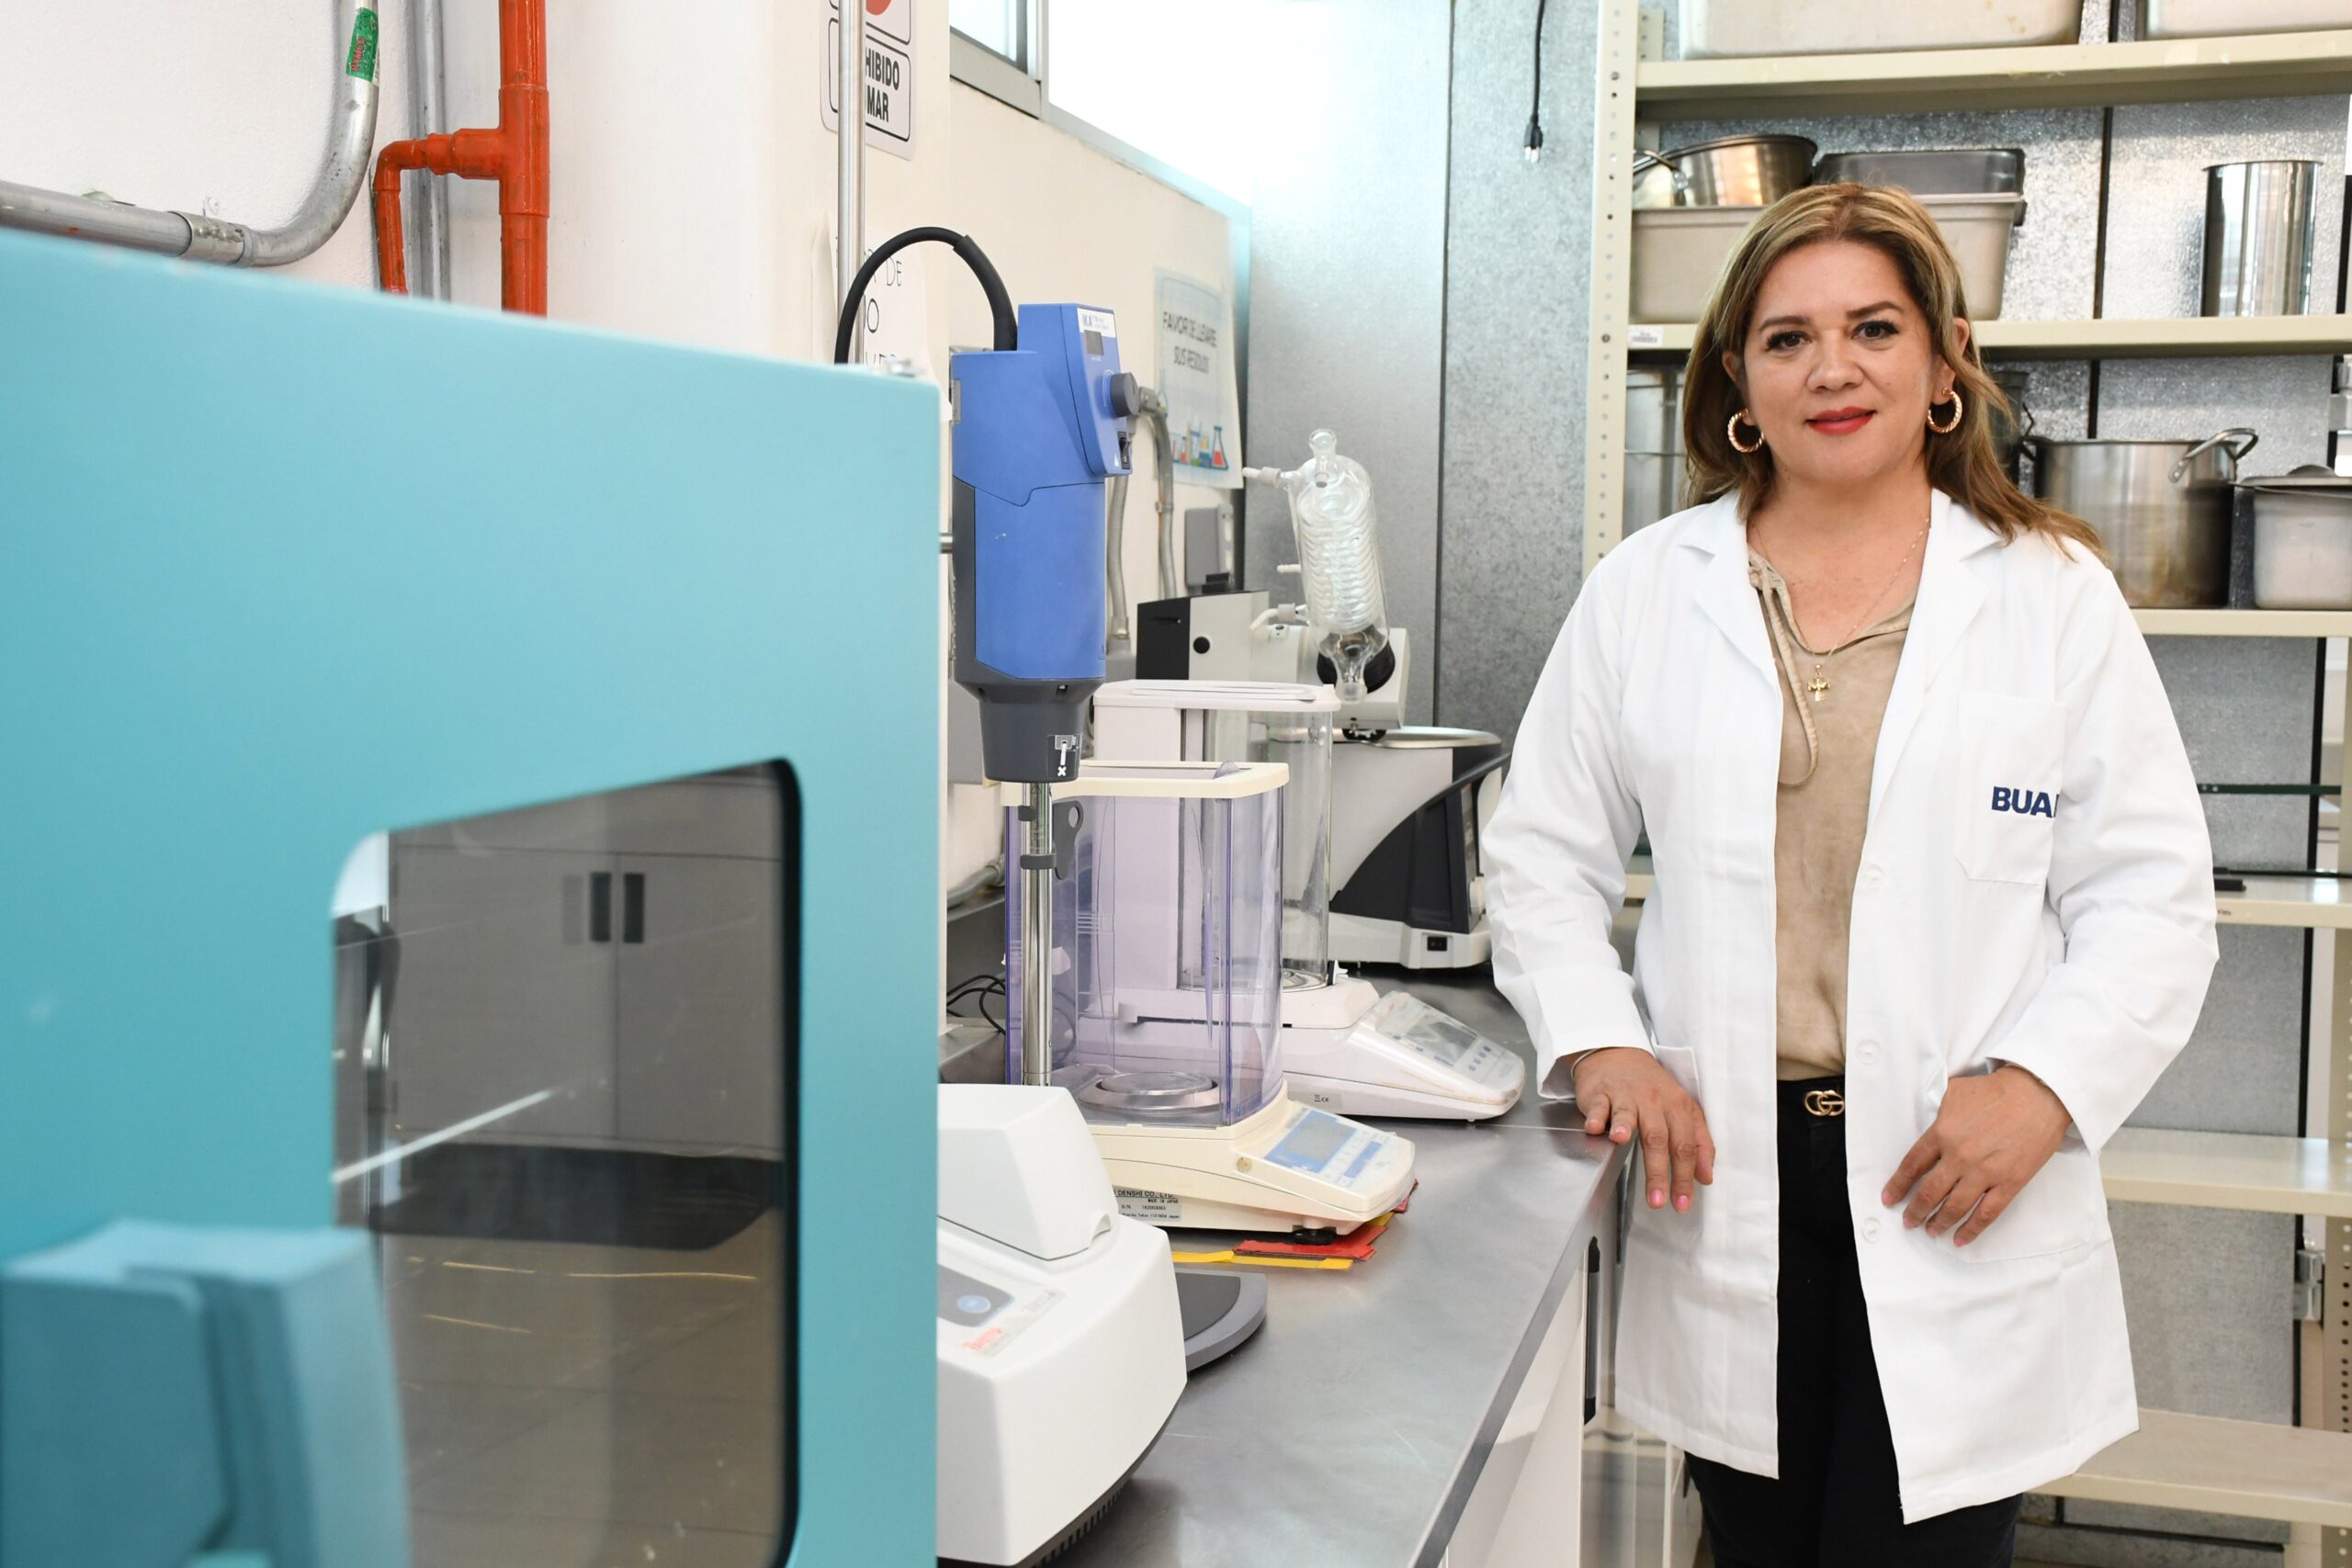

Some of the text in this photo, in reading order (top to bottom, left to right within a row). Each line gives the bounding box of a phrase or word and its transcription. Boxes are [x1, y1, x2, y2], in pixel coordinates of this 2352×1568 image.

[865, 46, 900, 91] HIBIDO
[866, 85, 889, 122] MAR
[1163, 310, 1189, 336] FAVOR
[1991, 785, 2060, 818] BUA
